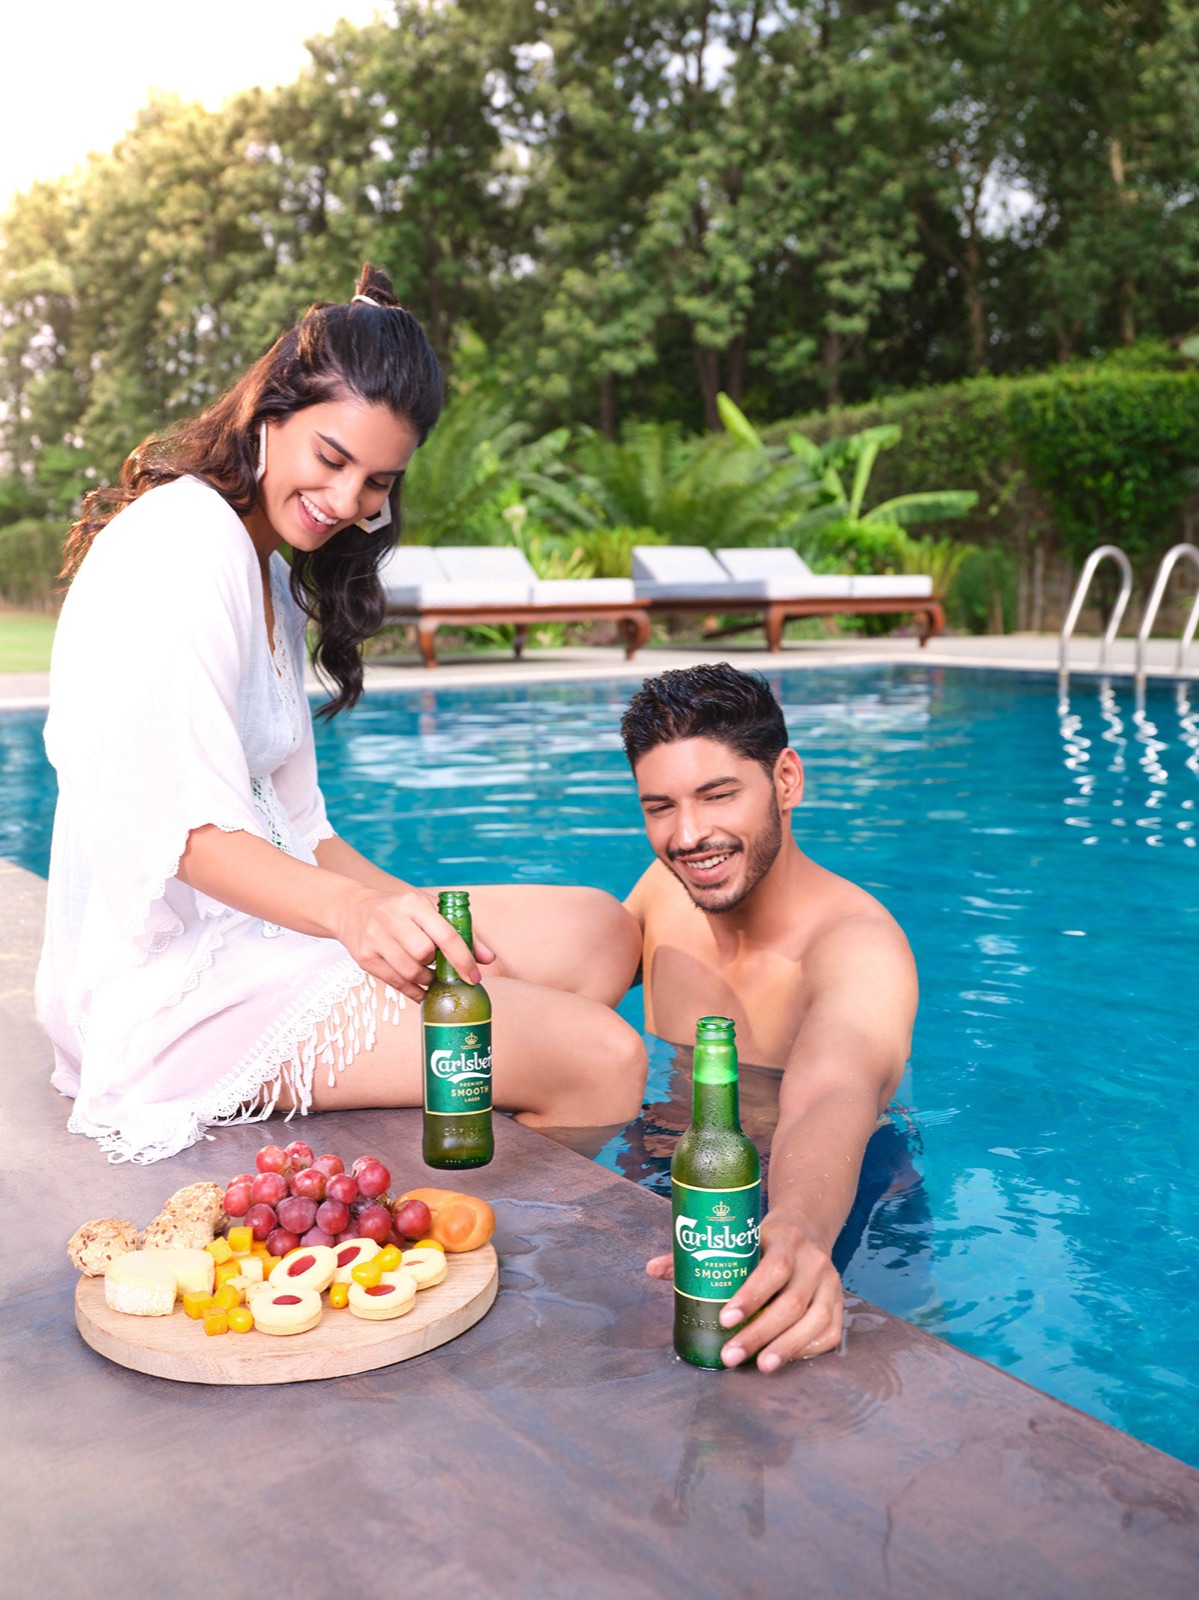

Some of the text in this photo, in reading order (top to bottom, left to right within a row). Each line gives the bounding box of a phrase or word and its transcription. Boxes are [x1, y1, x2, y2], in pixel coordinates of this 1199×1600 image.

[430, 1046, 492, 1084] Carlsber
[450, 1086, 489, 1097] SMOOTH
[675, 1214, 761, 1261] Carlsberg
[694, 1267, 748, 1280] SMOOTH
[681, 1314, 724, 1331] CARLS
